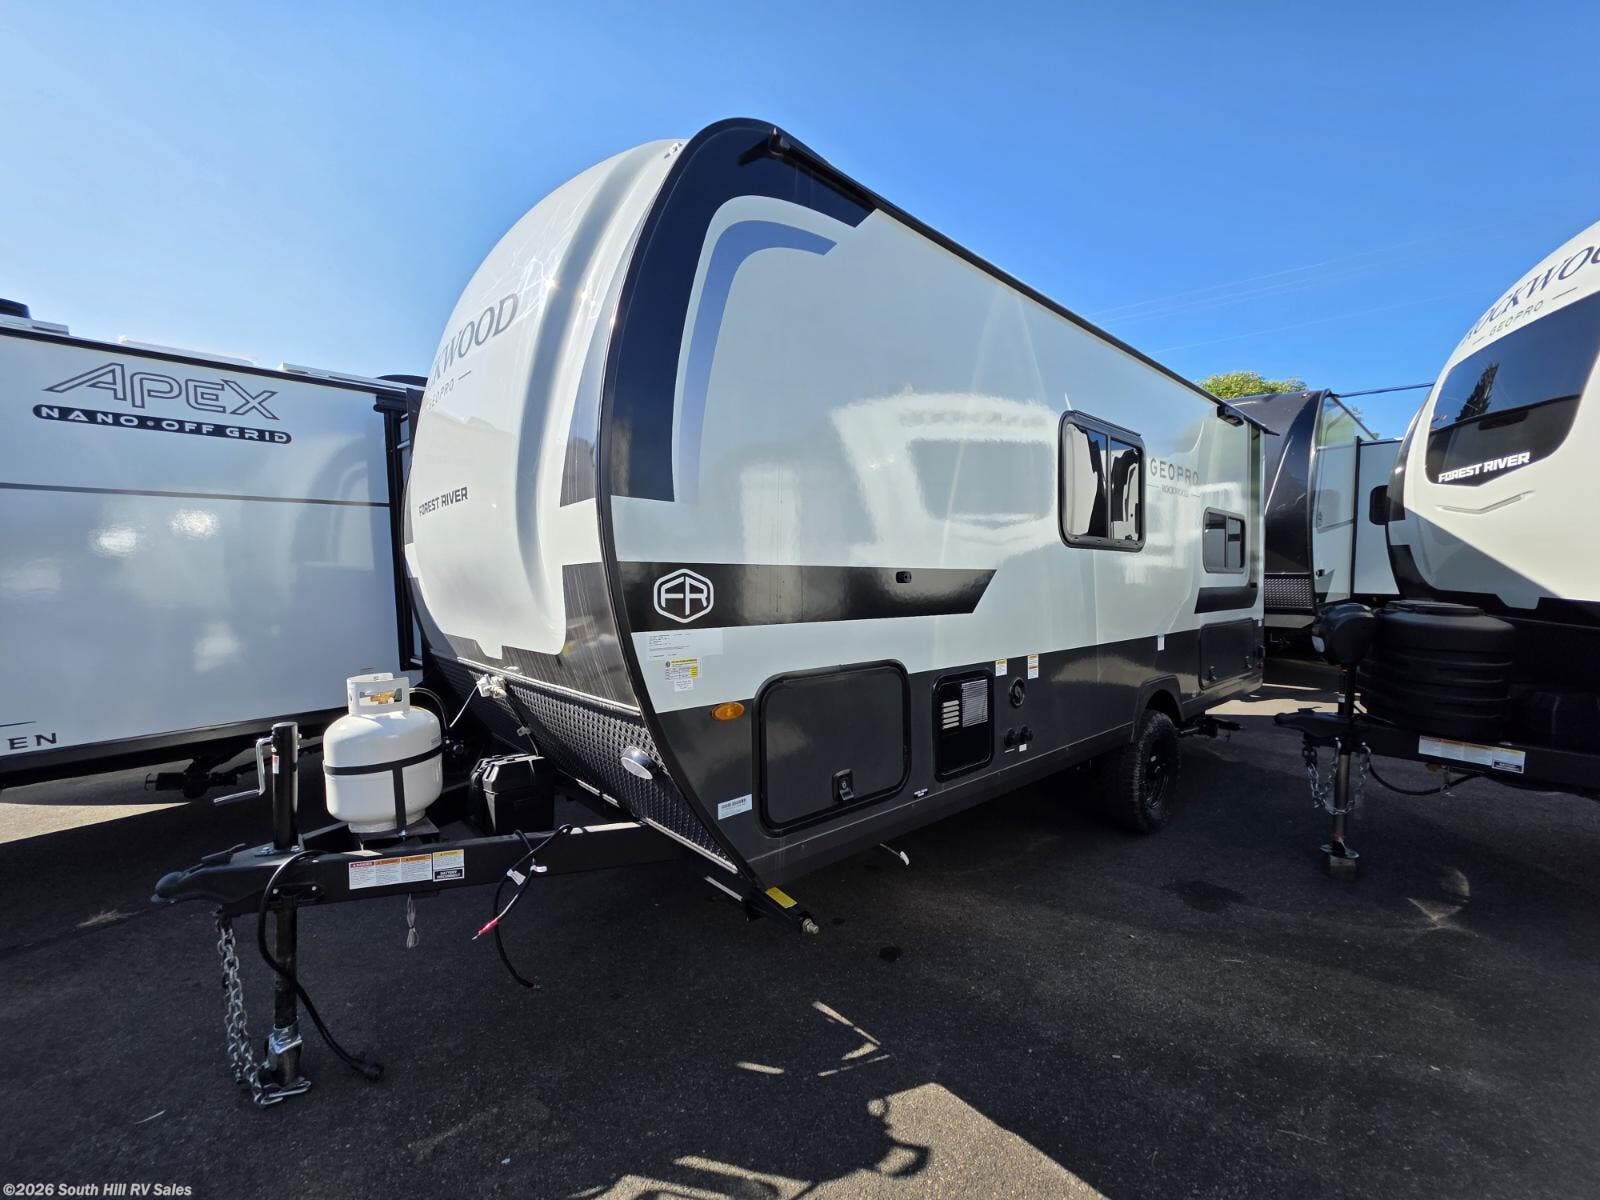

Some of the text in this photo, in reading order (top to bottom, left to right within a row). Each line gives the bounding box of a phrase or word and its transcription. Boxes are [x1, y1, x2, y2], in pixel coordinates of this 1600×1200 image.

[1489, 300, 1544, 336] GEOPRO
[42, 362, 280, 420] APEX
[226, 427, 287, 443] GRID
[1150, 457, 1199, 486] GEOPRO
[1438, 452, 1531, 483] FOREST RIVER
[418, 486, 468, 517] FOREST RIVER
